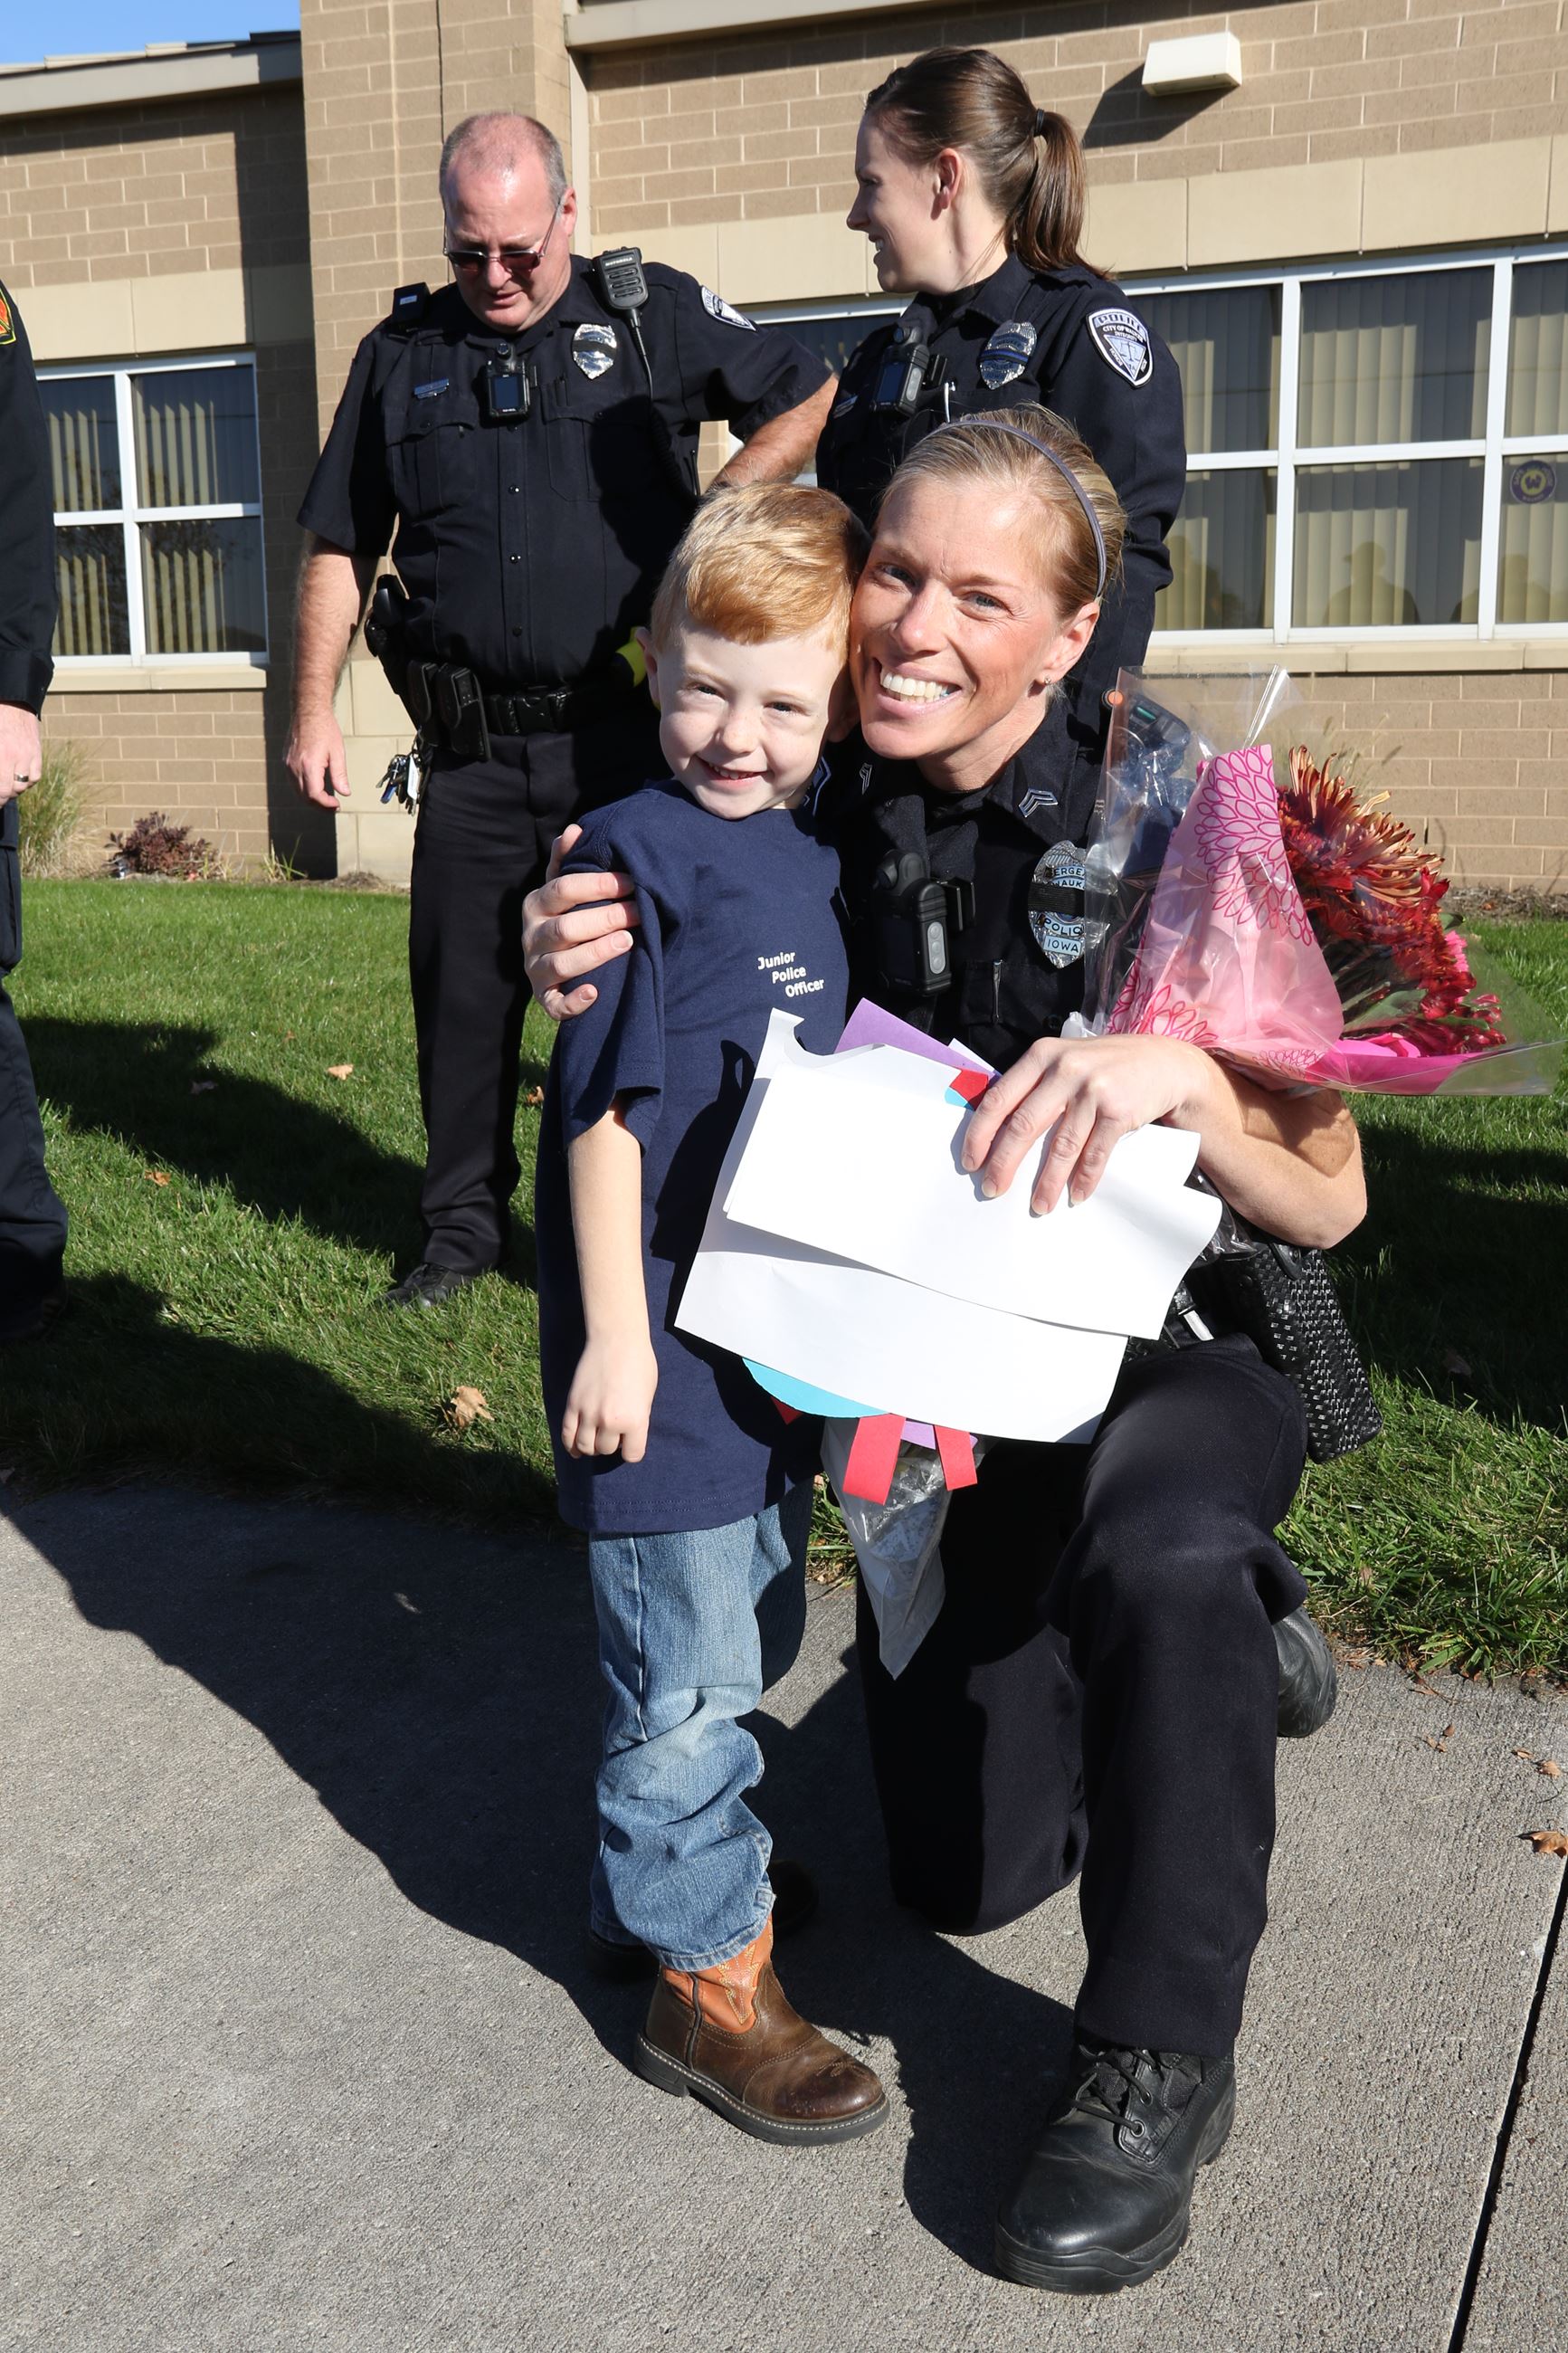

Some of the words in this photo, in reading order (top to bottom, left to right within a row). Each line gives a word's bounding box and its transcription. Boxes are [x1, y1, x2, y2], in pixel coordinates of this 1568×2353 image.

[1097, 313, 1144, 333] POLICE
[1051, 866, 1086, 877] ERGE
[1043, 917, 1085, 937] POLIC
[1047, 938, 1079, 954] IOWA
[757, 951, 796, 970] Junior
[772, 966, 806, 985] Police
[784, 978, 825, 997] Officer
